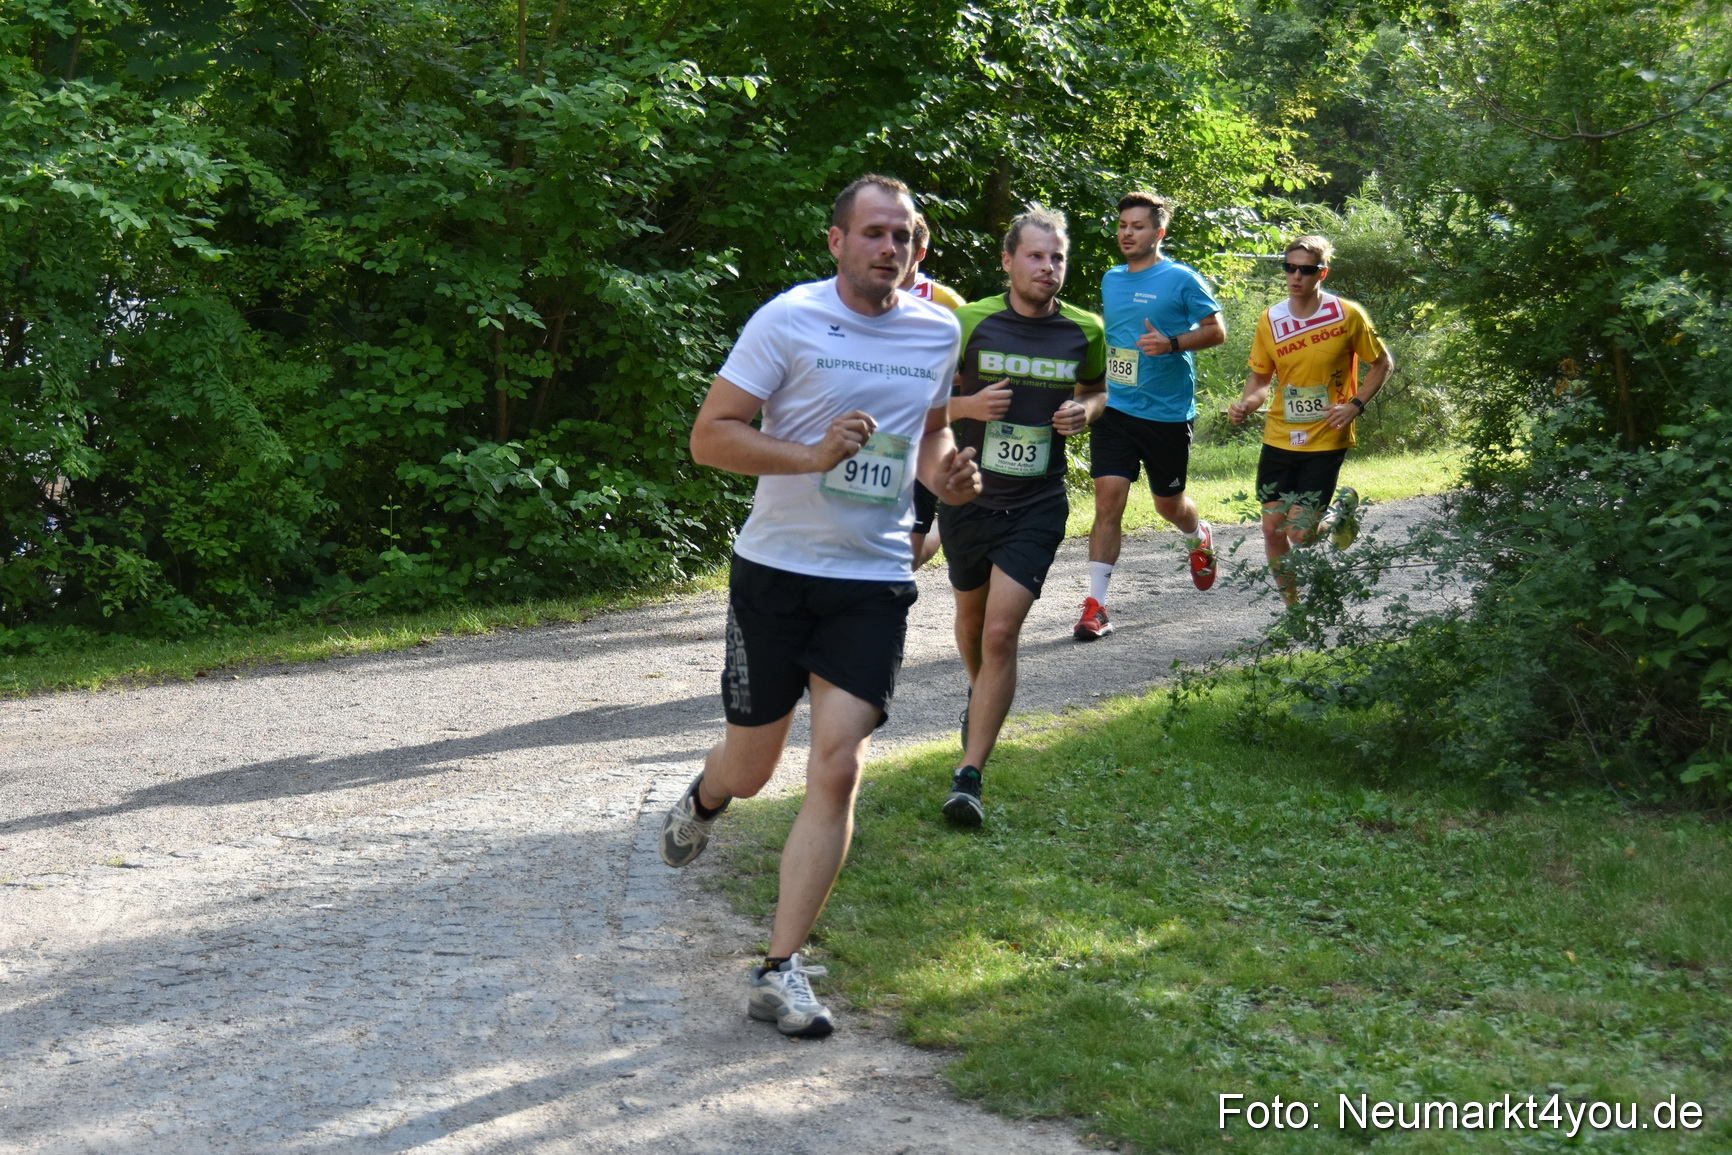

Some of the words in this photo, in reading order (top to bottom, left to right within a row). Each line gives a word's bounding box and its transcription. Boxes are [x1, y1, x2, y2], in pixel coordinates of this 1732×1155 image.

[1276, 338, 1308, 358] MAX
[1310, 325, 1348, 345] BÖGL
[816, 358, 884, 374] RUPPRECHT
[891, 364, 938, 381] HOLZBAU
[979, 352, 1078, 381] BOCK
[1108, 359, 1132, 375] 1858
[978, 372, 1006, 383] inspire
[1010, 377, 1020, 386] by
[1022, 380, 1047, 388] smart
[1287, 398, 1323, 413] 1638
[997, 441, 1037, 463] 303
[844, 459, 891, 488] 9110
